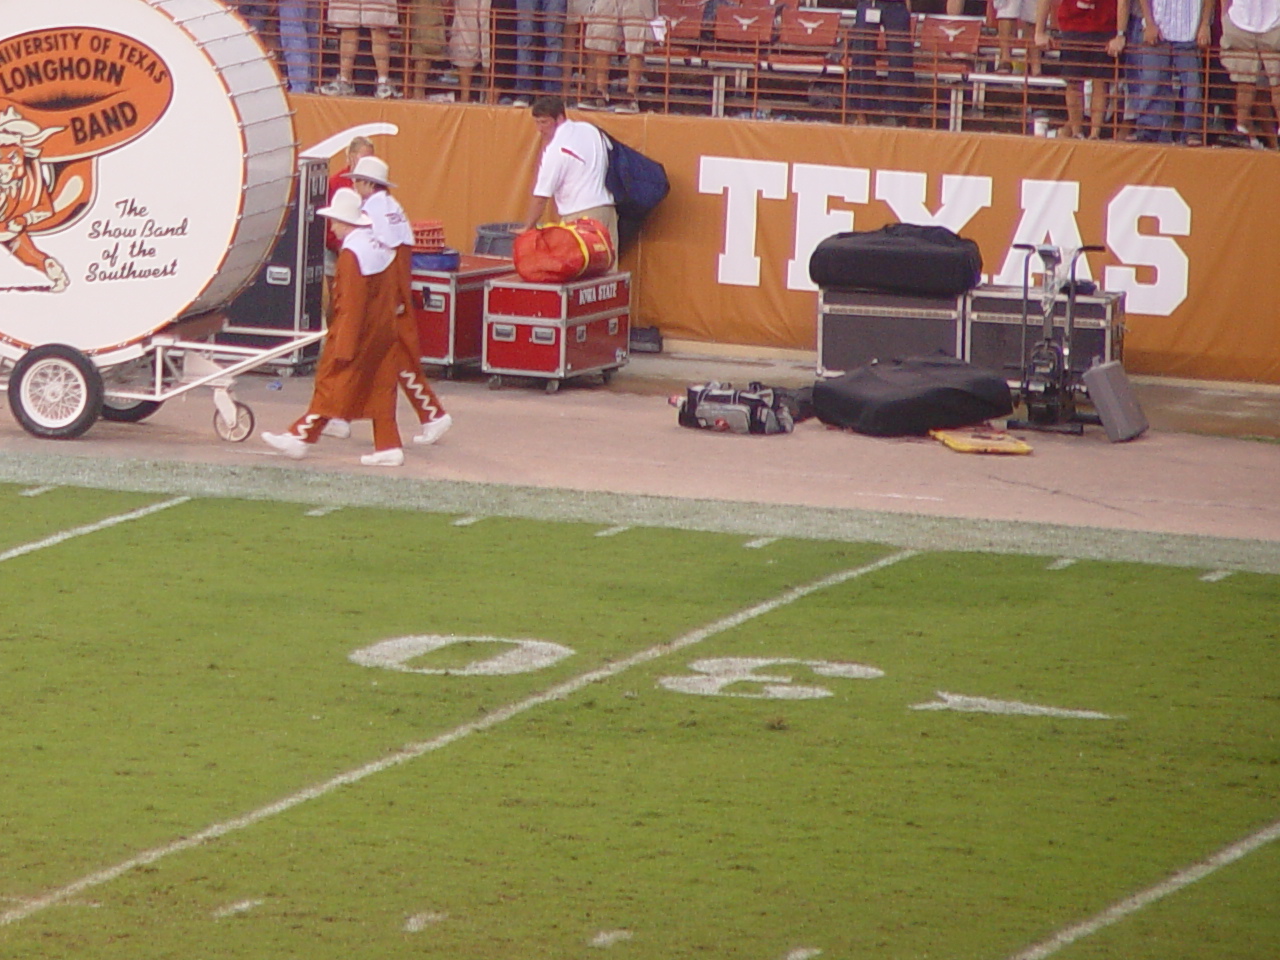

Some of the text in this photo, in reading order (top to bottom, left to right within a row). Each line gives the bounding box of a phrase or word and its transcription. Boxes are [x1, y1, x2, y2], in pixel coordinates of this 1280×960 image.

[89, 35, 112, 55] OF
[118, 44, 170, 84] TEXAS
[70, 101, 138, 146] BAND
[115, 198, 149, 218] The
[88, 216, 189, 240] Show Band
[699, 155, 1191, 316] TEXAS
[101, 240, 157, 268] of the
[85, 259, 178, 283] Southwest
[598, 281, 618, 301] STATE
